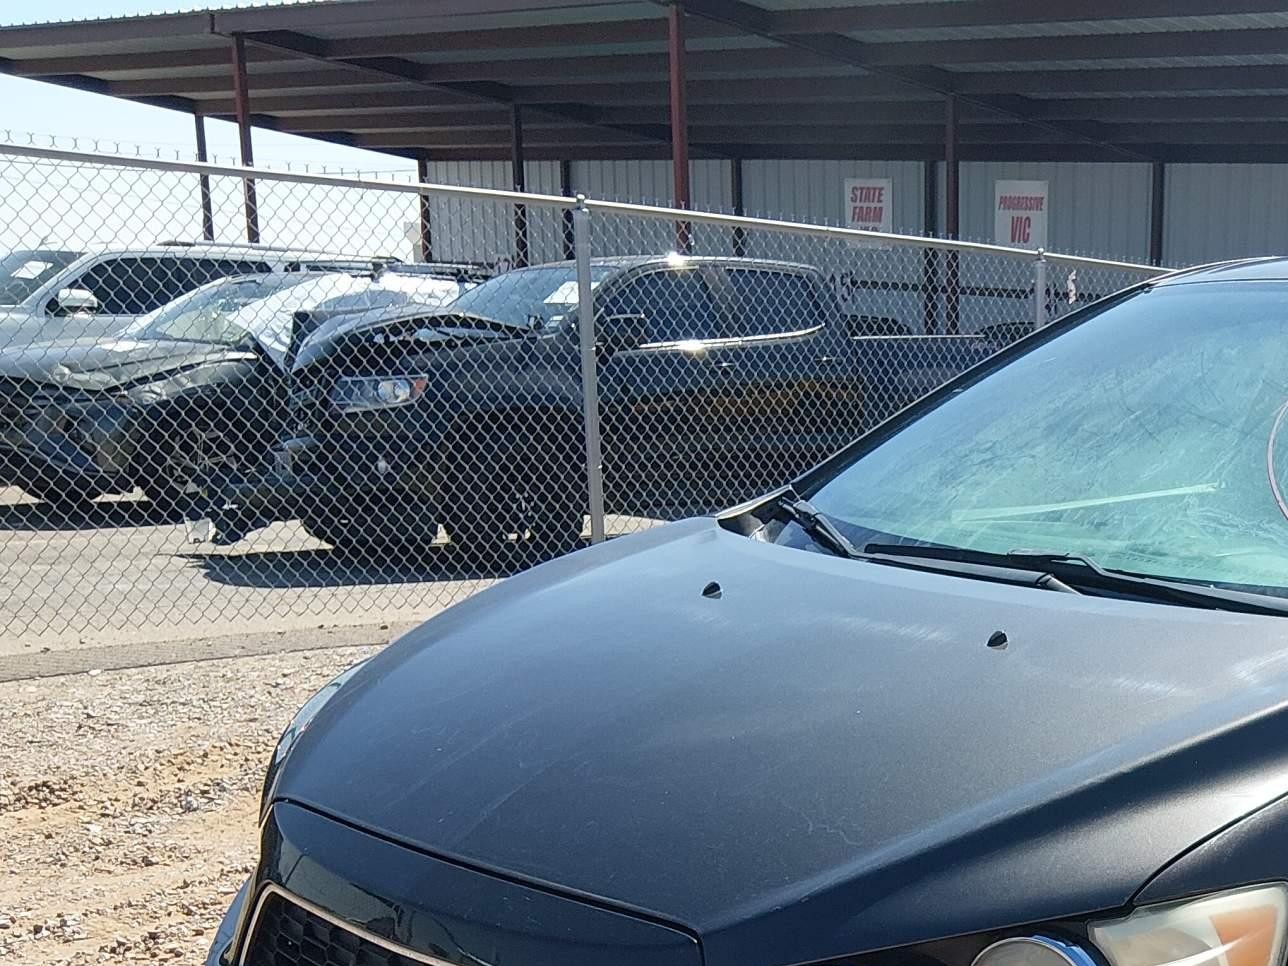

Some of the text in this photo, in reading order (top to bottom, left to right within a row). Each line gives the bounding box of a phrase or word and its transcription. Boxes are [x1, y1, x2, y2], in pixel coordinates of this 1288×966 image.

[850, 186, 885, 203] STATE
[998, 195, 1045, 211] PROGRESSIVE
[851, 206, 884, 223] FARM
[1010, 215, 1032, 244] VIC
